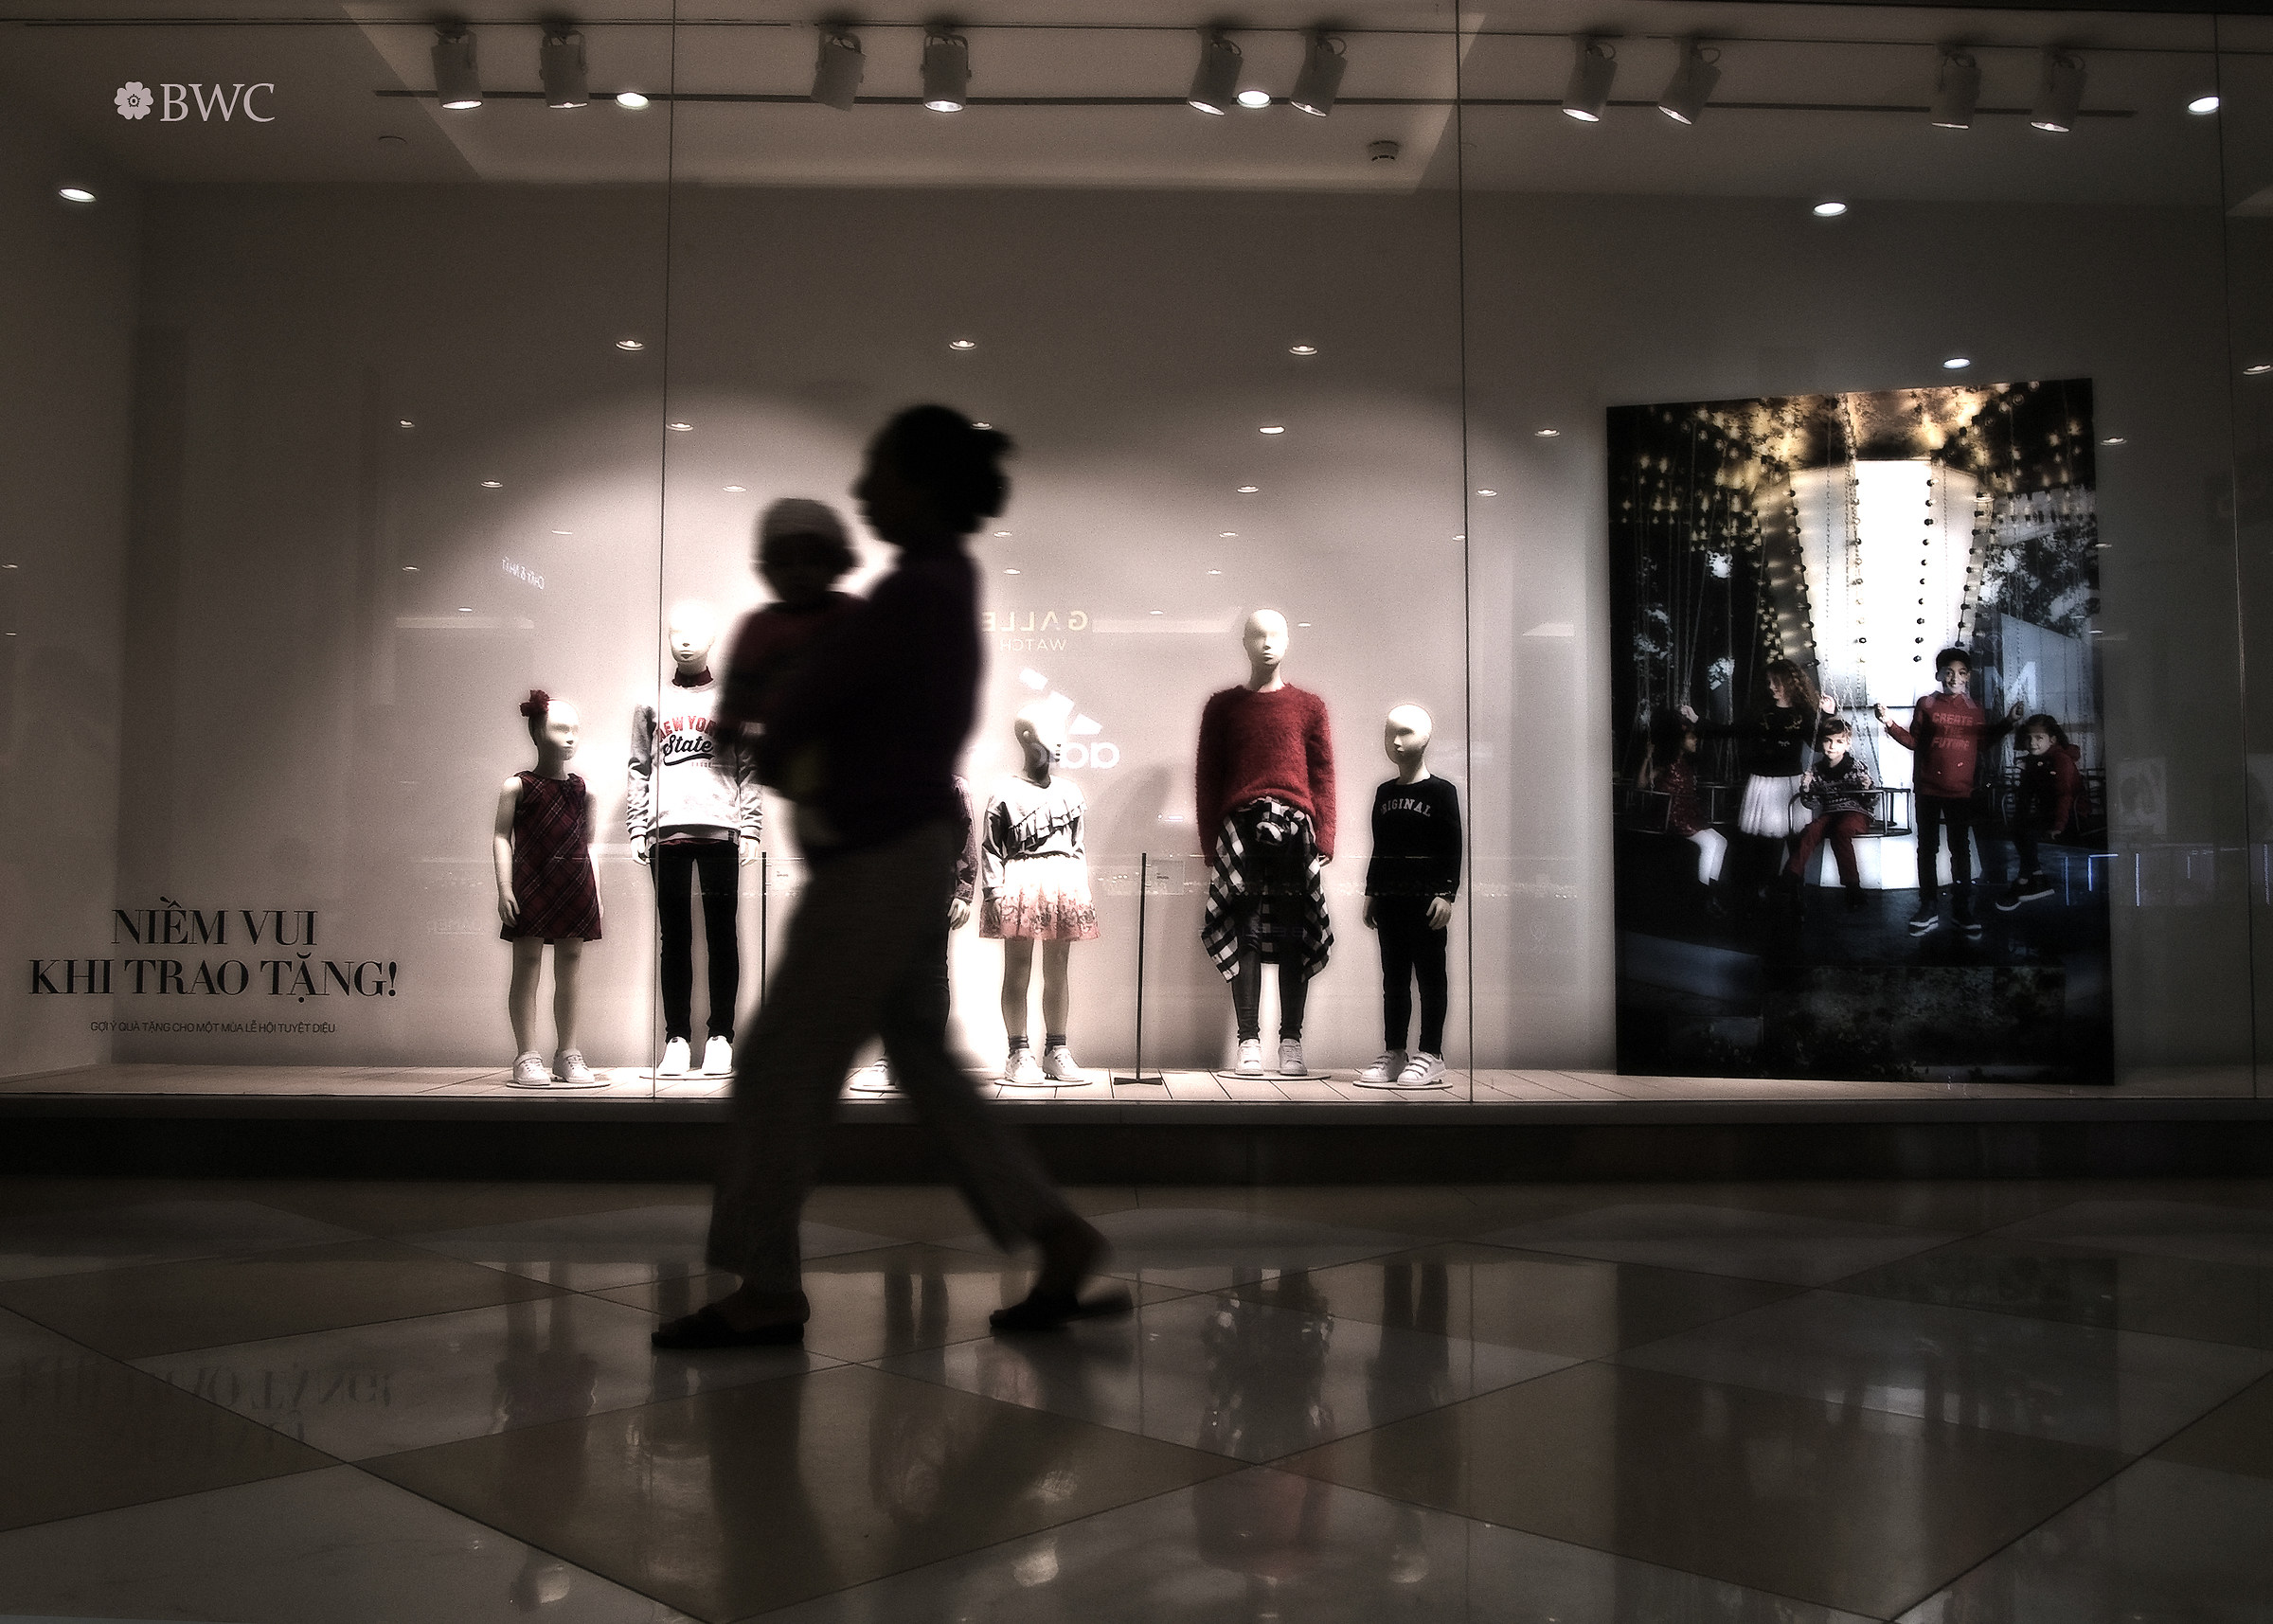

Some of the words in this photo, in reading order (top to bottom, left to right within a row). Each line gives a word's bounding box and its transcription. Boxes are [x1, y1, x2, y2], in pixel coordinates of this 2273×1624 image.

[663, 735, 713, 757] State
[111, 897, 228, 945] NIỀM
[239, 909, 318, 946] VUI
[28, 959, 115, 994] KHI
[124, 959, 250, 996] TRAO
[260, 952, 398, 1003] TẶNG!
[172, 1023, 195, 1032] CHO
